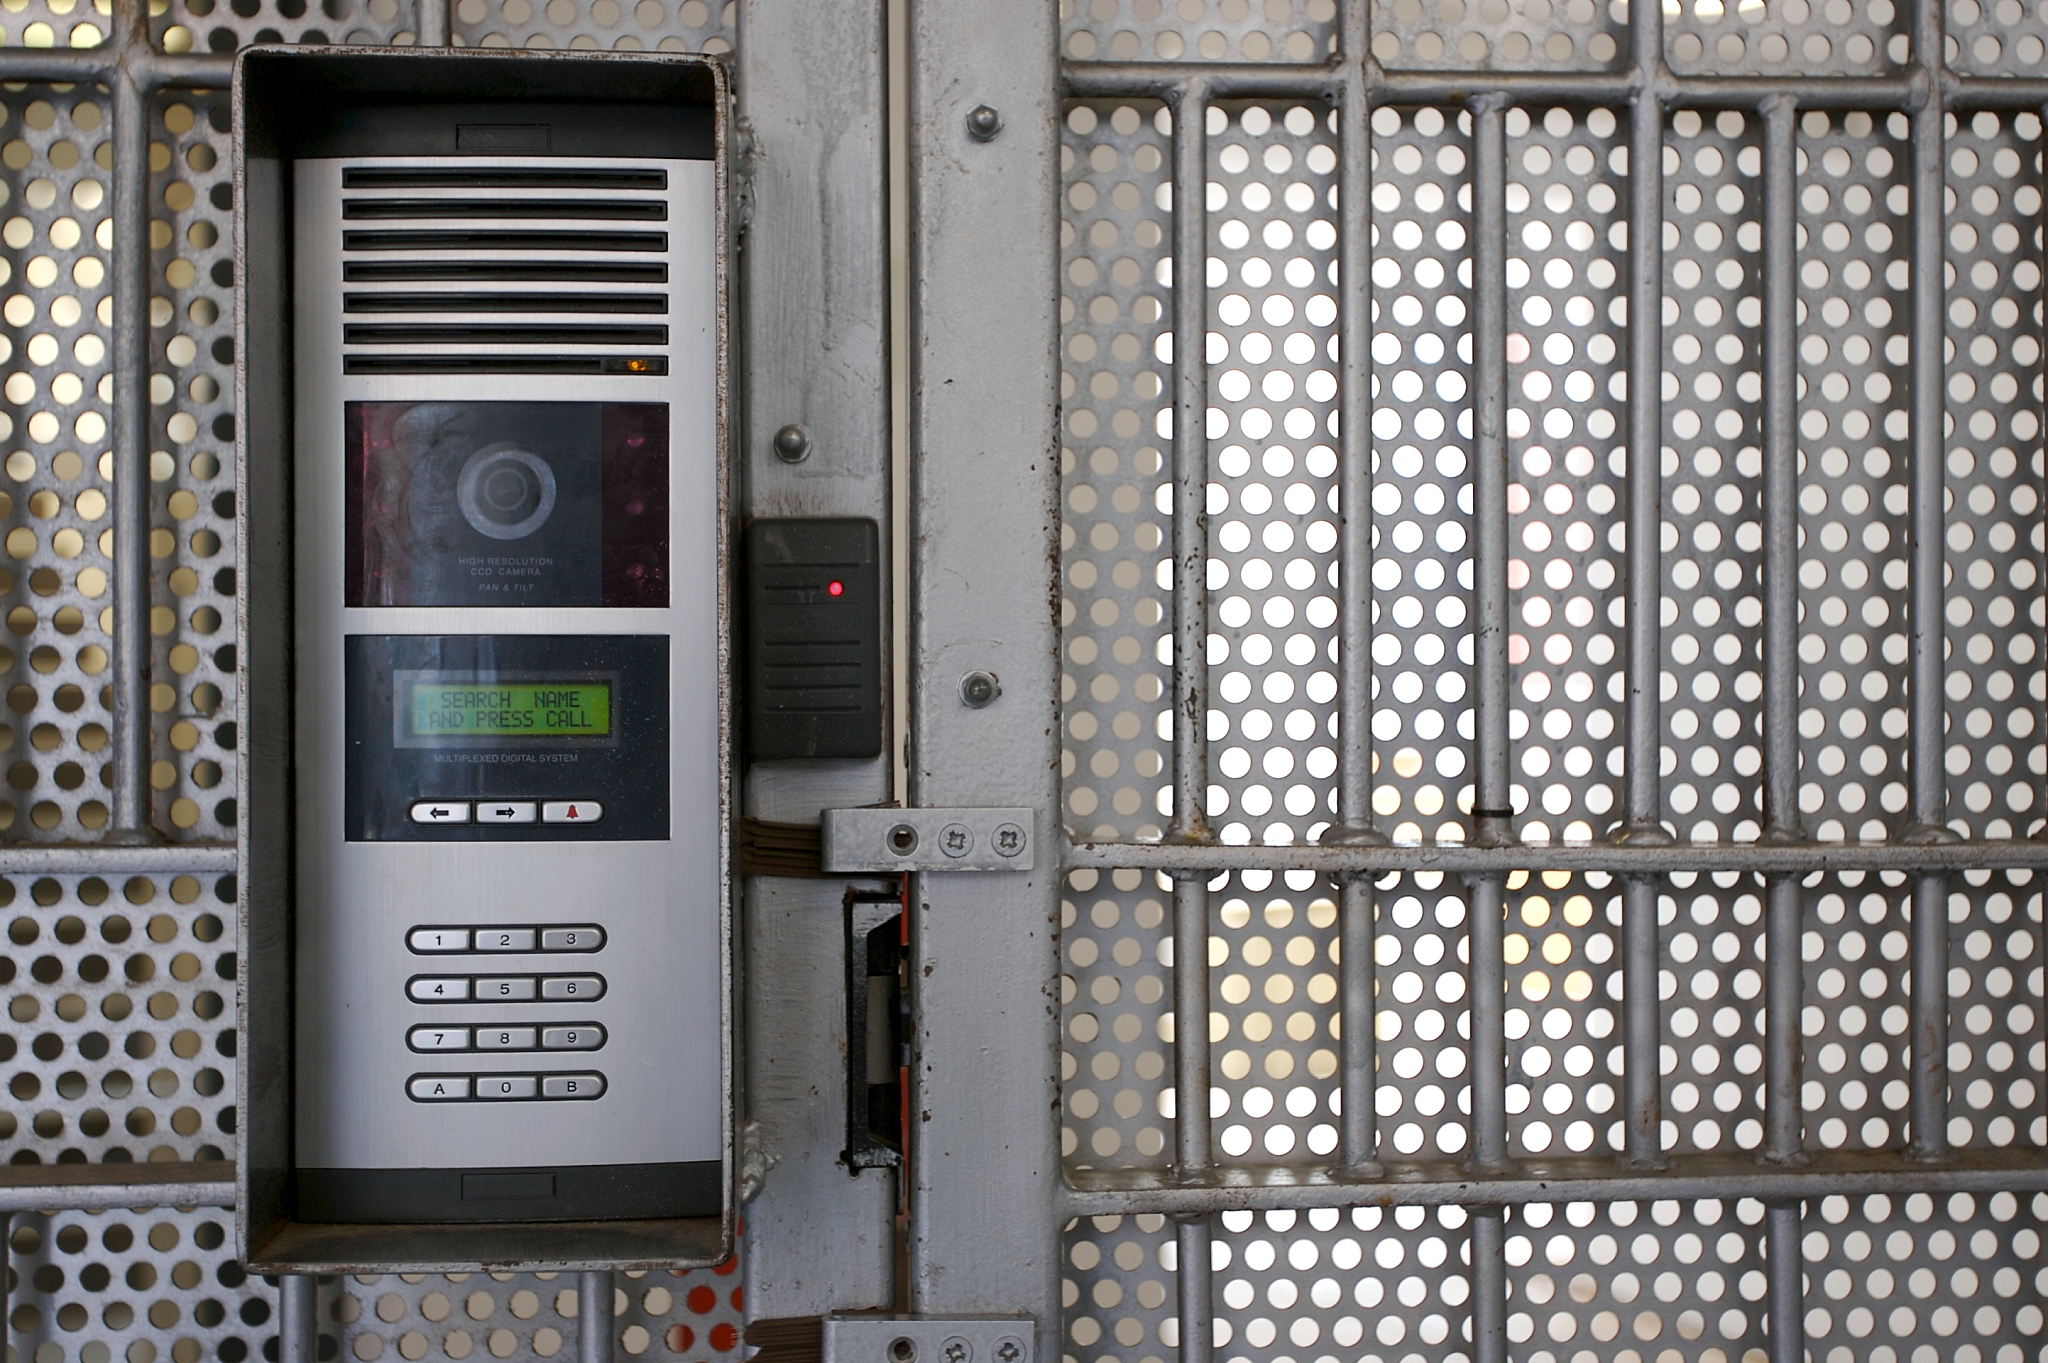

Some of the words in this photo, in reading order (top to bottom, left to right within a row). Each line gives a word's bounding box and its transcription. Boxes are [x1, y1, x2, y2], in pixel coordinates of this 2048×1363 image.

[458, 557, 484, 566] HIGH
[487, 557, 553, 566] RESOLUTION
[470, 568, 493, 576] CCD
[498, 568, 541, 576] CAMERA
[478, 583, 499, 592] PAN
[503, 583, 510, 592] &
[514, 583, 534, 592] TILT
[441, 691, 511, 708] SEARCH
[534, 691, 580, 708] NAME
[430, 713, 464, 728] AND
[476, 712, 534, 728] PRESS
[546, 711, 592, 728] CALL
[434, 755, 499, 763] MULTIPLEXED
[501, 754, 537, 763] DIGITAL
[539, 754, 578, 762] SYSTEM
[435, 935, 442, 946] 1
[500, 935, 510, 946] 2
[566, 934, 577, 944] 3
[434, 985, 444, 995] 4
[500, 984, 510, 995] 5
[567, 983, 577, 994] 6
[434, 1034, 444, 1045] 7
[500, 1033, 510, 1044] 8
[567, 1032, 577, 1043] 9
[434, 1083, 445, 1094] A
[567, 1081, 578, 1092] B
